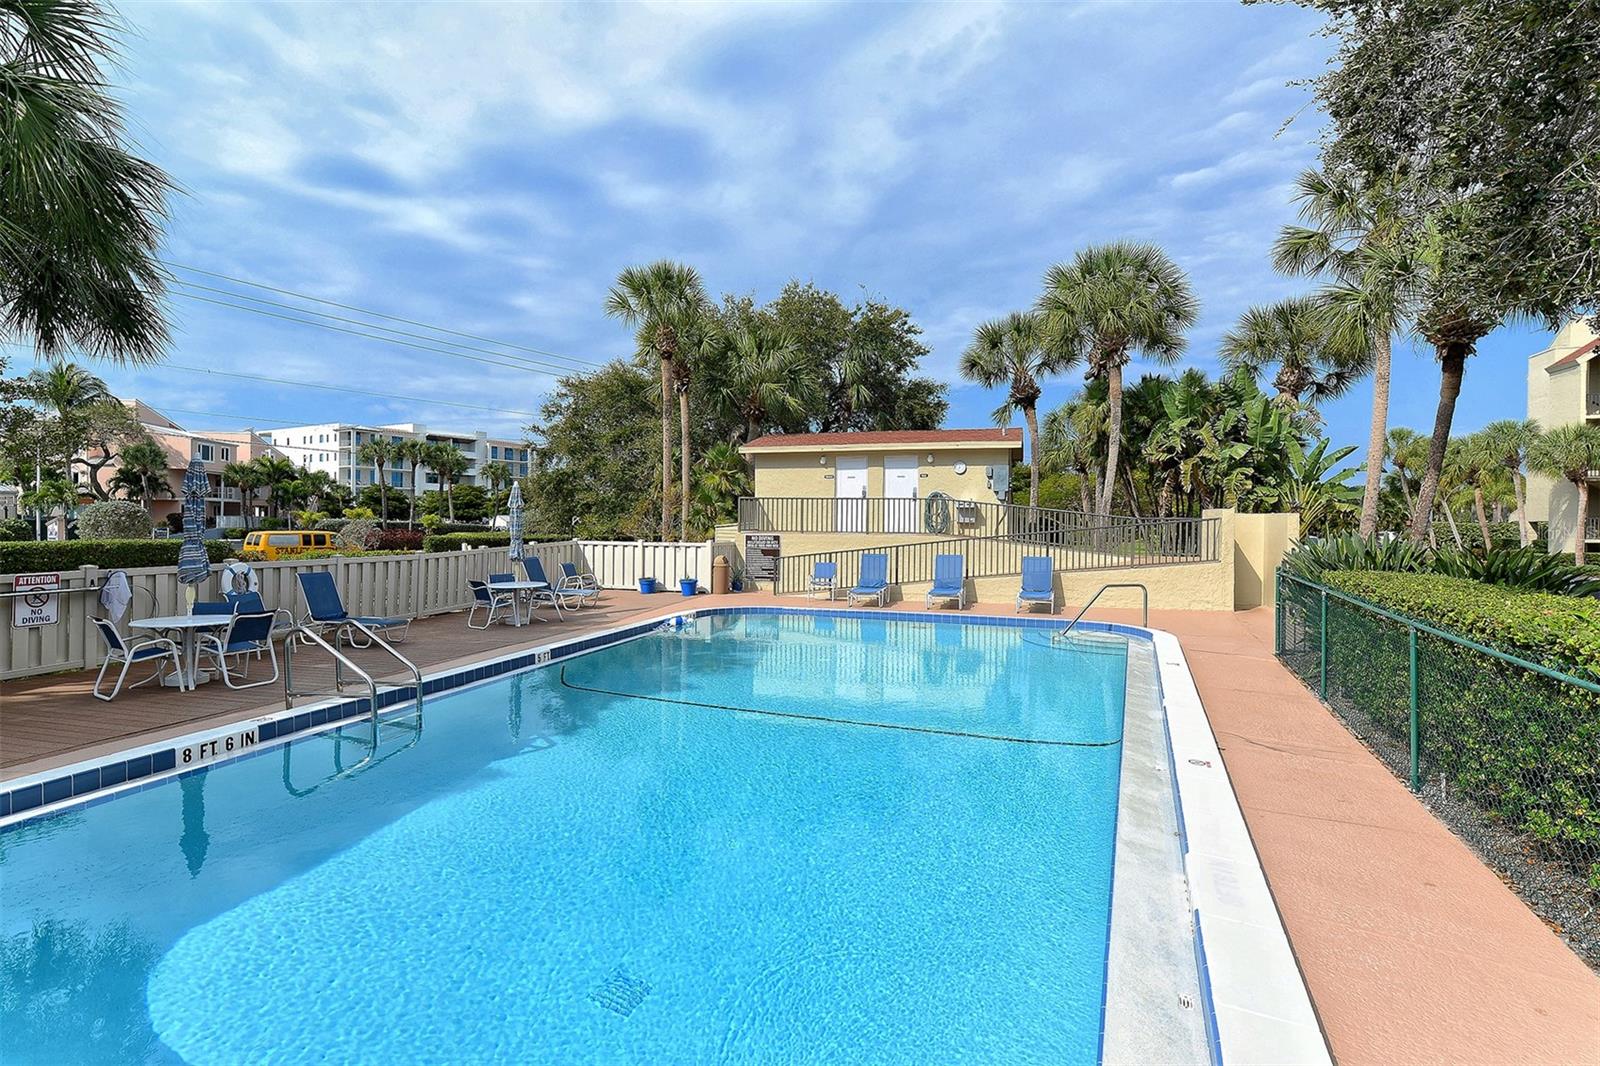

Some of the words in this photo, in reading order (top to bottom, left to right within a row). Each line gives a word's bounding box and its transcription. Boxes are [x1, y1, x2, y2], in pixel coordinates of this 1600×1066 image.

[18, 575, 57, 586] ATTENTION
[31, 608, 43, 616] NO
[22, 615, 50, 625] DIVING
[182, 748, 192, 763] 8
[225, 737, 234, 751] 6
